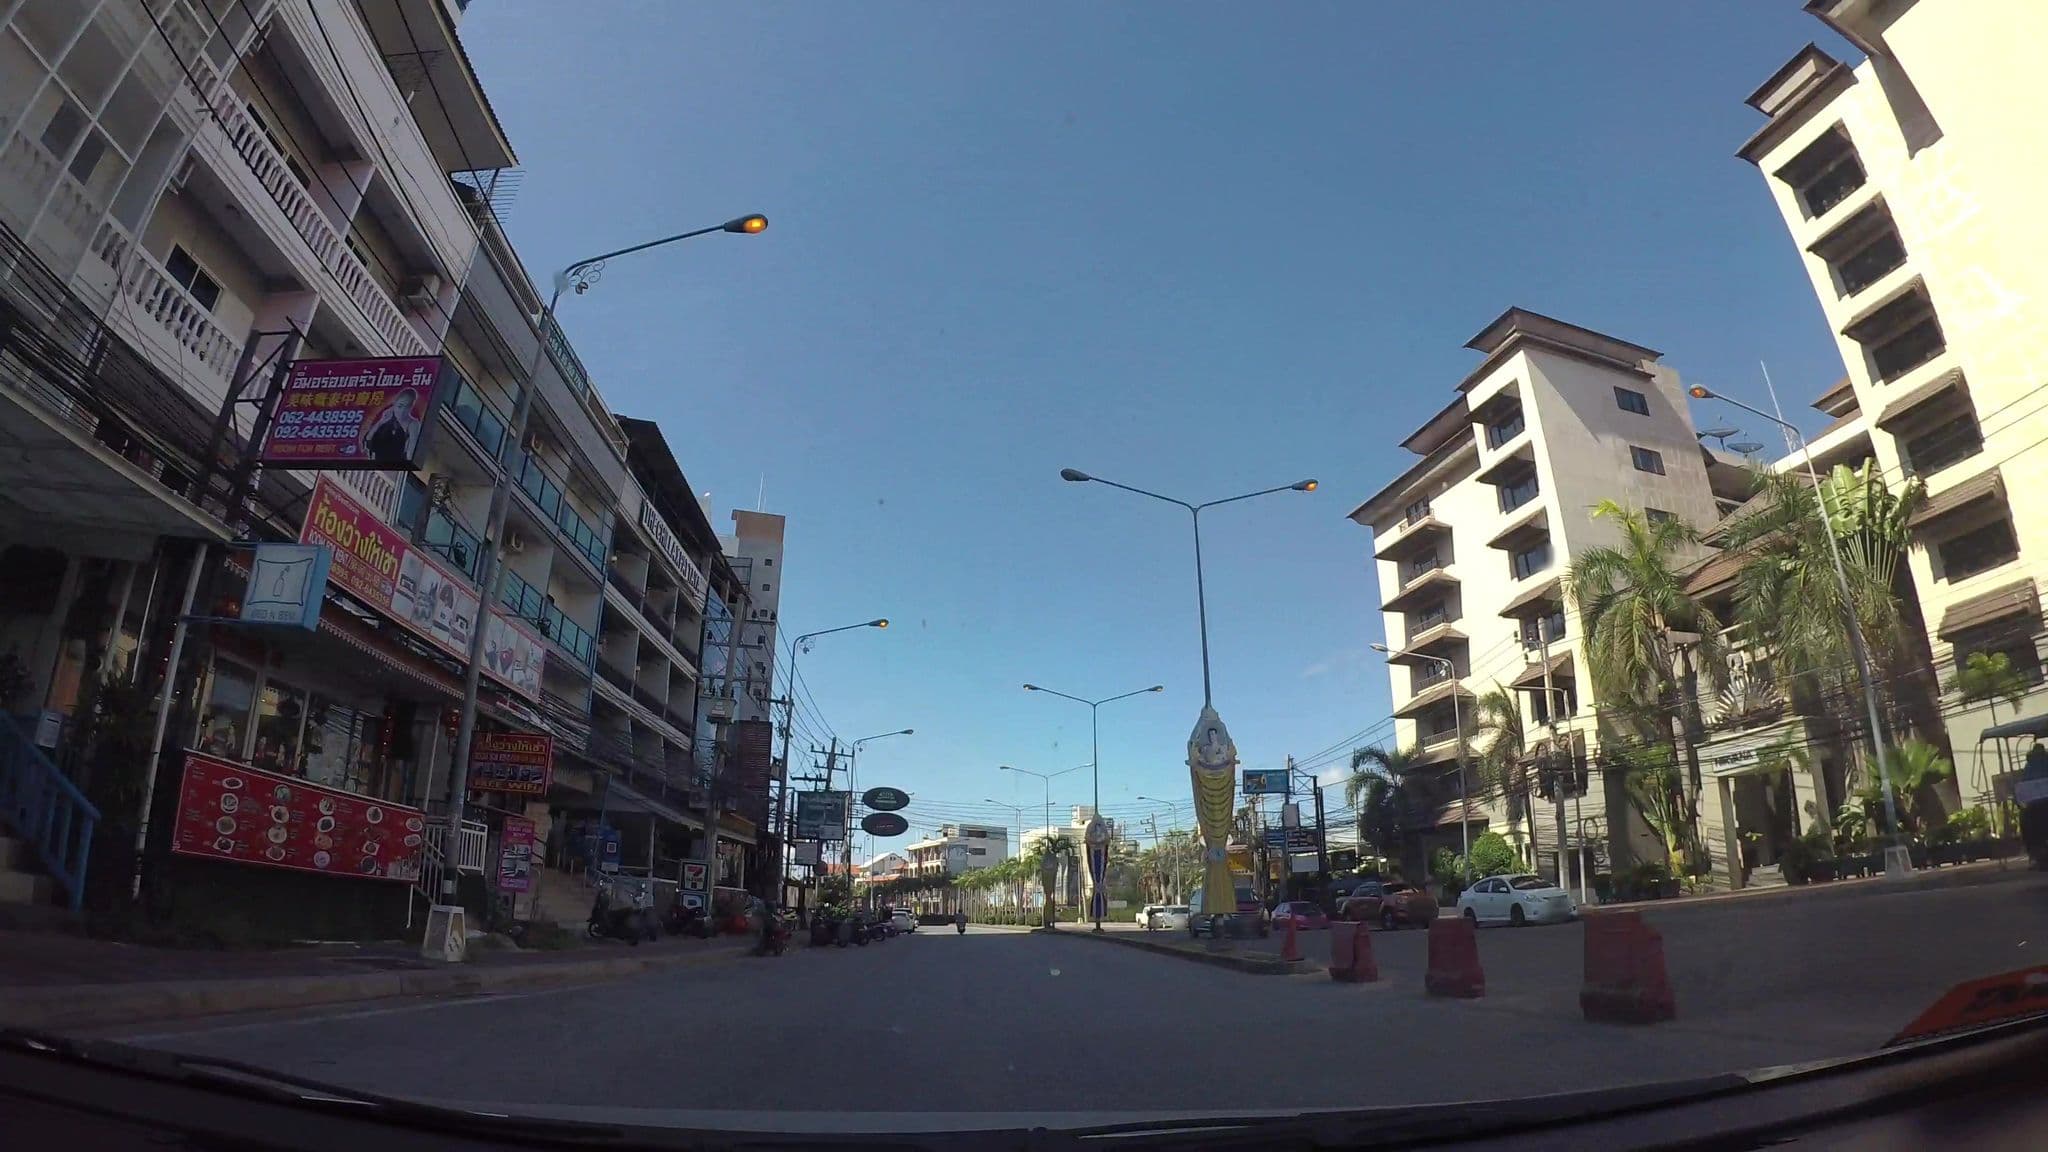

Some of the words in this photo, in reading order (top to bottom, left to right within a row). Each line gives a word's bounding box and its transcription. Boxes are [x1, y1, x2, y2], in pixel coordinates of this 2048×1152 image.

[279, 409, 364, 425] 062-4438595
[274, 425, 360, 439] 092-6435356
[313, 493, 398, 580] ห้องว่างให้เช่า
